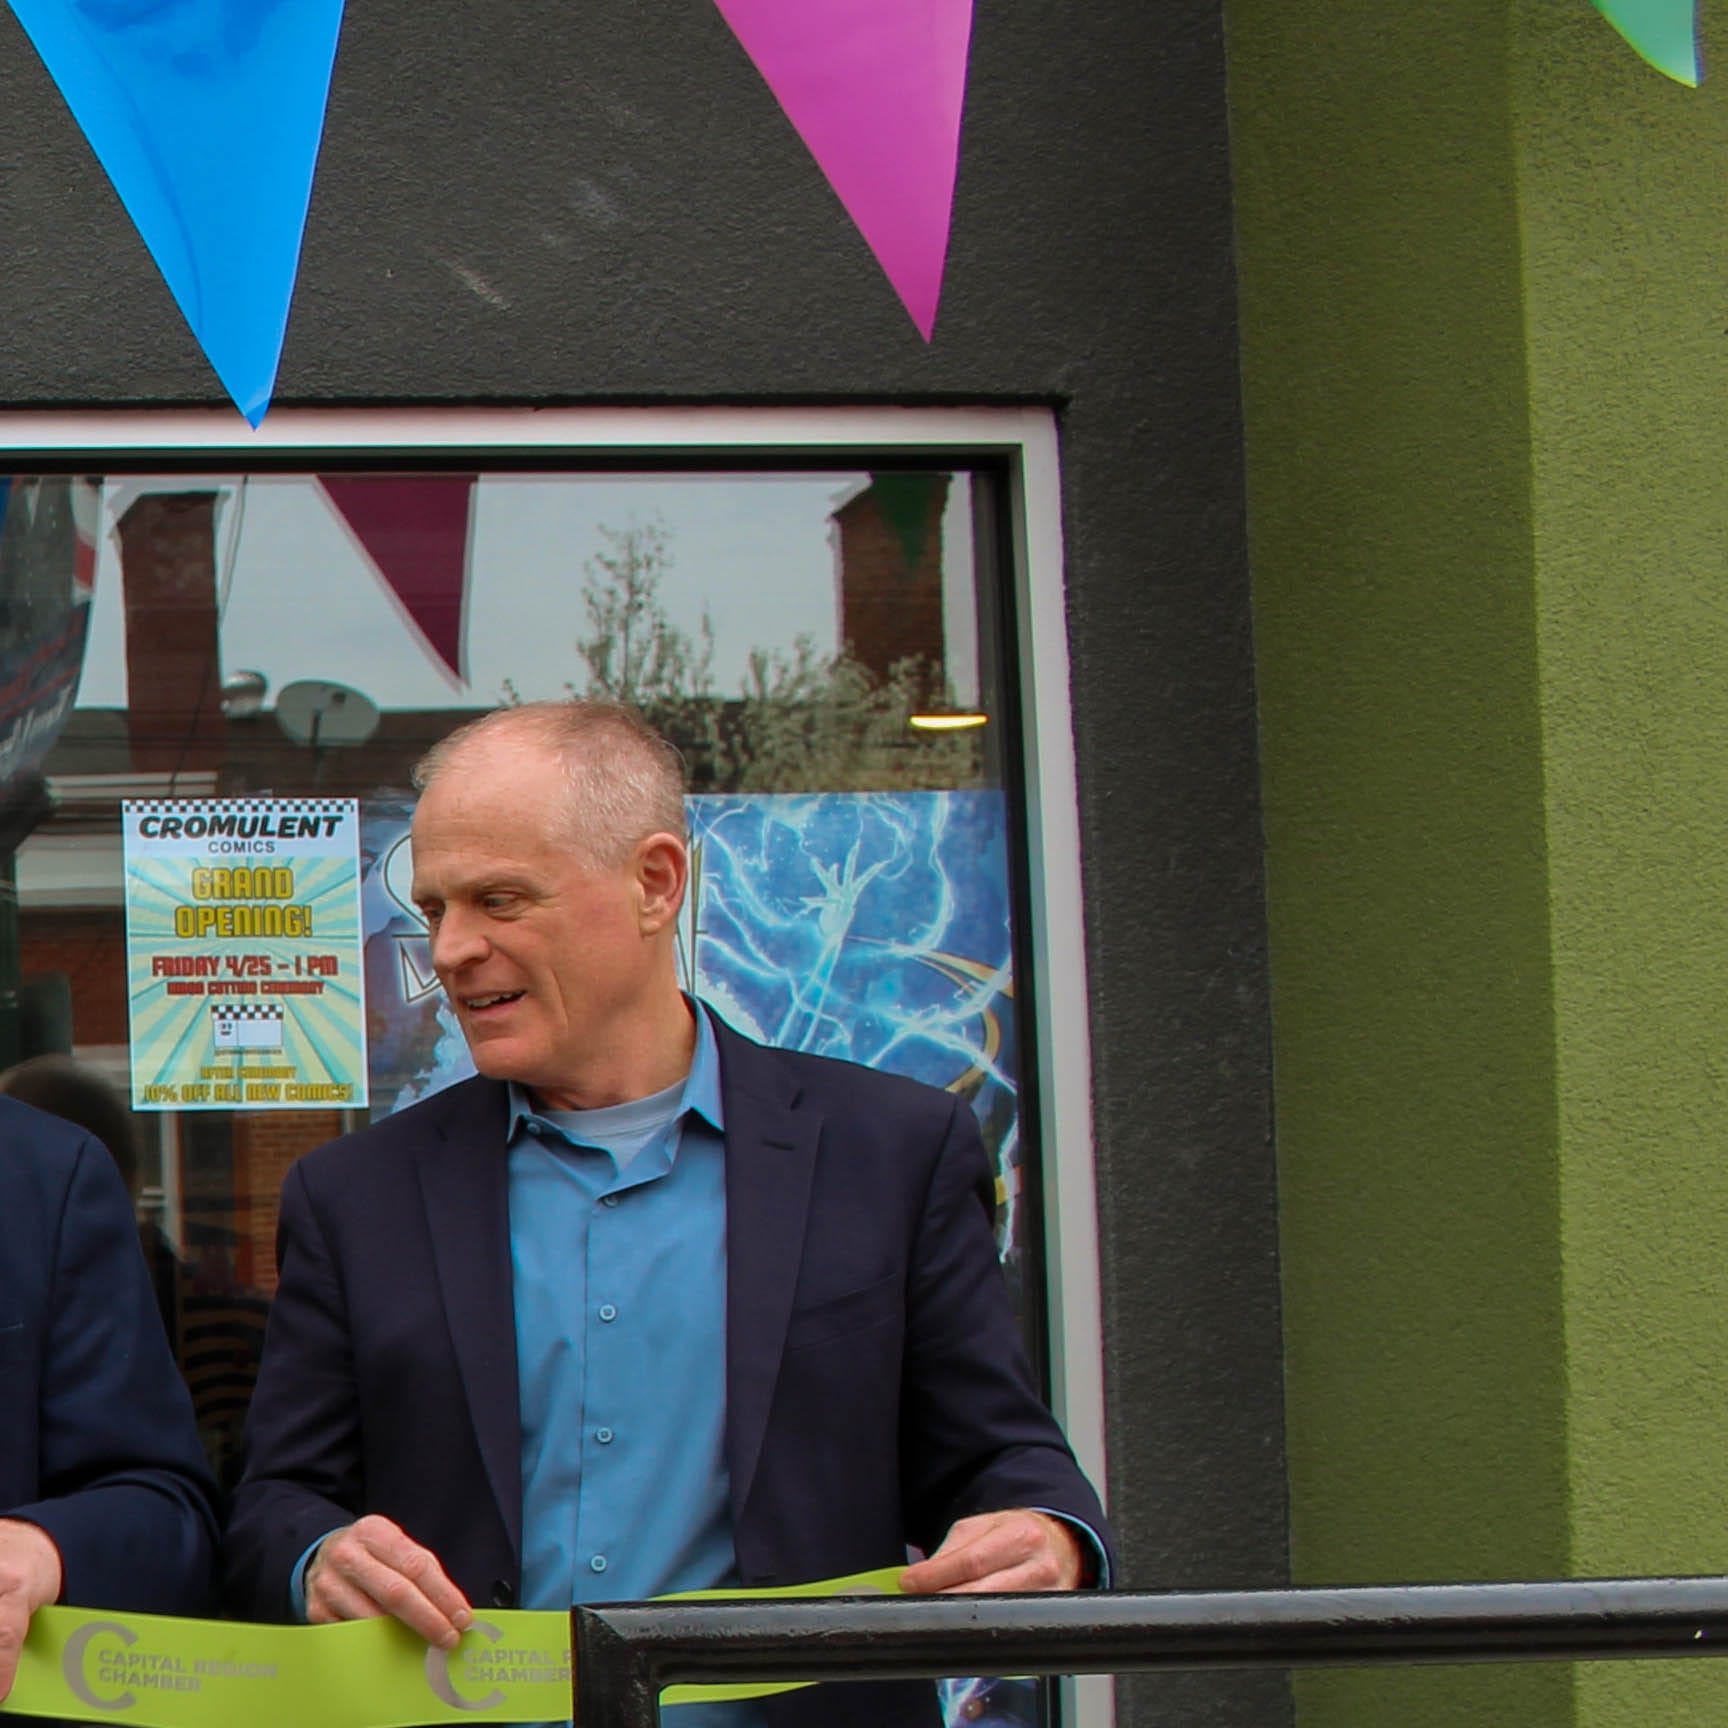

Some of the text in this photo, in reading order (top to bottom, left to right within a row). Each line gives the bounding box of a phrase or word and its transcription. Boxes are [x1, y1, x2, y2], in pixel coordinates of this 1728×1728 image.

[139, 815, 344, 839] CROMULENT
[208, 841, 275, 853] COMICS
[192, 867, 294, 900] GRAND
[175, 905, 312, 938] OPENING!
[152, 956, 220, 977] FRIDAY
[225, 955, 272, 977] 4/25
[307, 955, 338, 976] PM
[98, 1649, 279, 1680] CAPITAL REGION
[463, 1648, 557, 1666] CAPITAL
[99, 1668, 203, 1693] CHAMBER
[463, 1667, 572, 1684] CHAMBER
